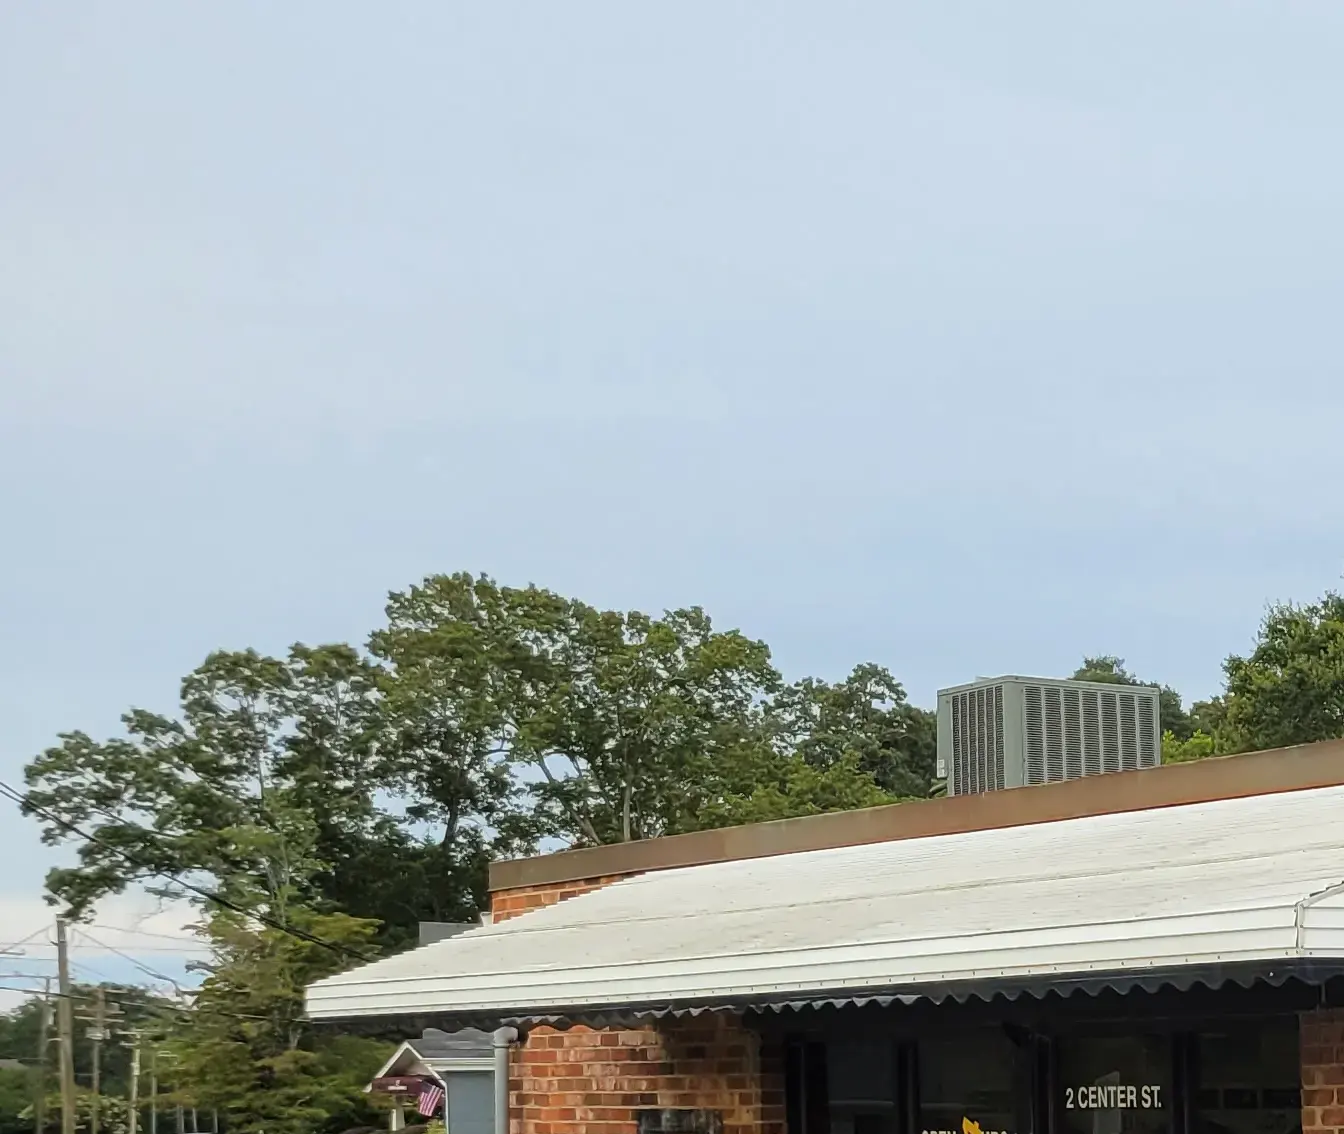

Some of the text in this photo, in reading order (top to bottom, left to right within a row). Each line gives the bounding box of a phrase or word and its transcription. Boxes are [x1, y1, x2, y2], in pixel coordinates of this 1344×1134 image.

[1066, 1085, 1162, 1109] 2 CENTER ST.
